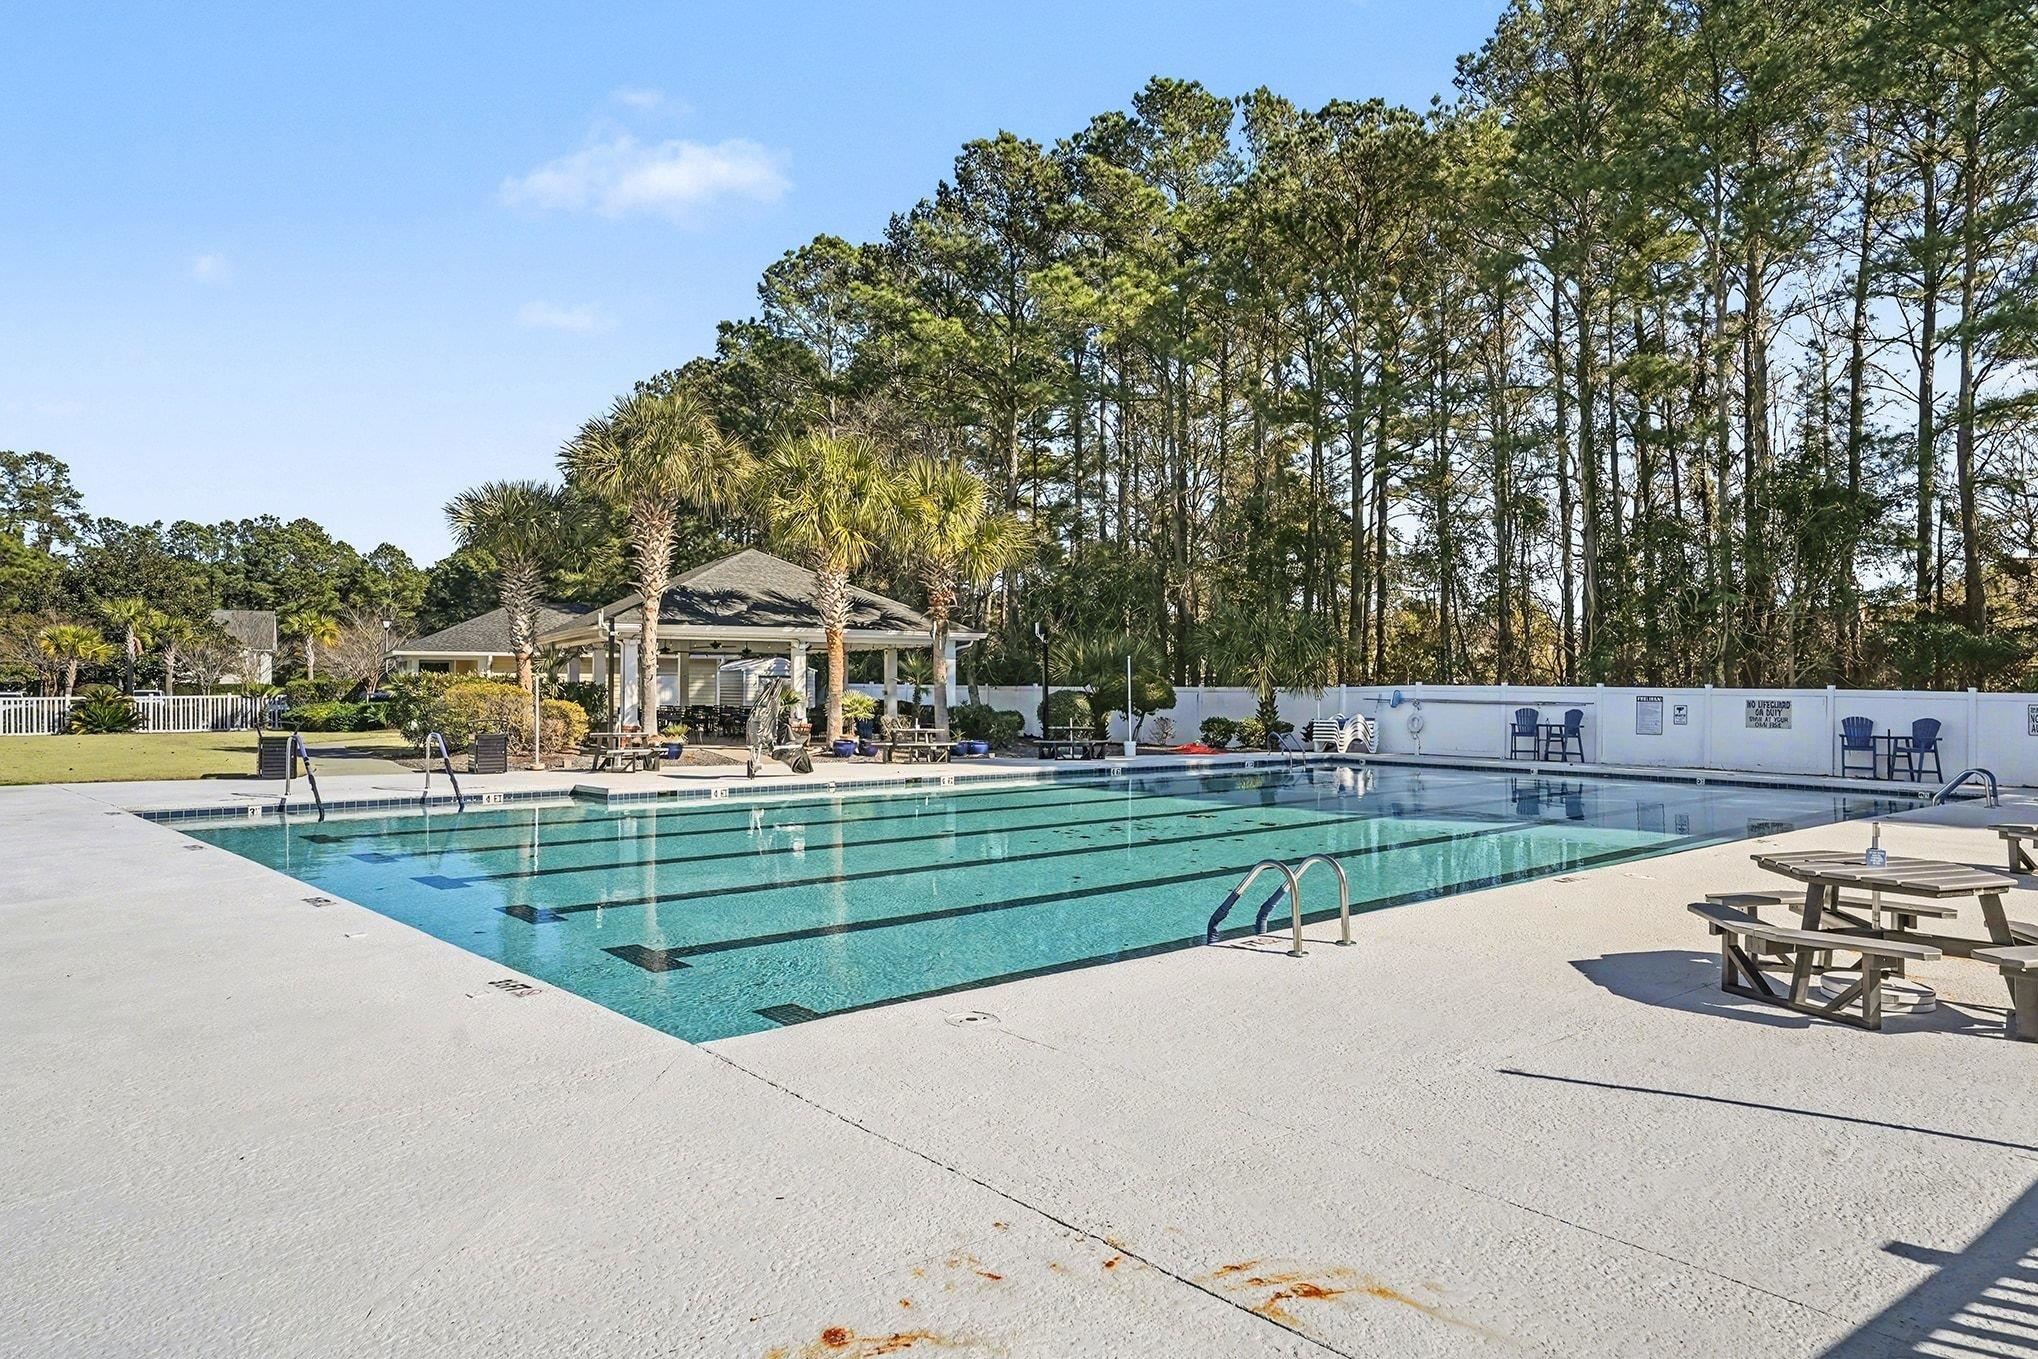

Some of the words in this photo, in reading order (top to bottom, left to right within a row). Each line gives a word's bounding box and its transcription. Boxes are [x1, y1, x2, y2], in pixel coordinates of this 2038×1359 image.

[1746, 700, 1756, 709] NO
[1758, 700, 1791, 709] LIFEGUARD
[1766, 709, 1782, 717] DUTY
